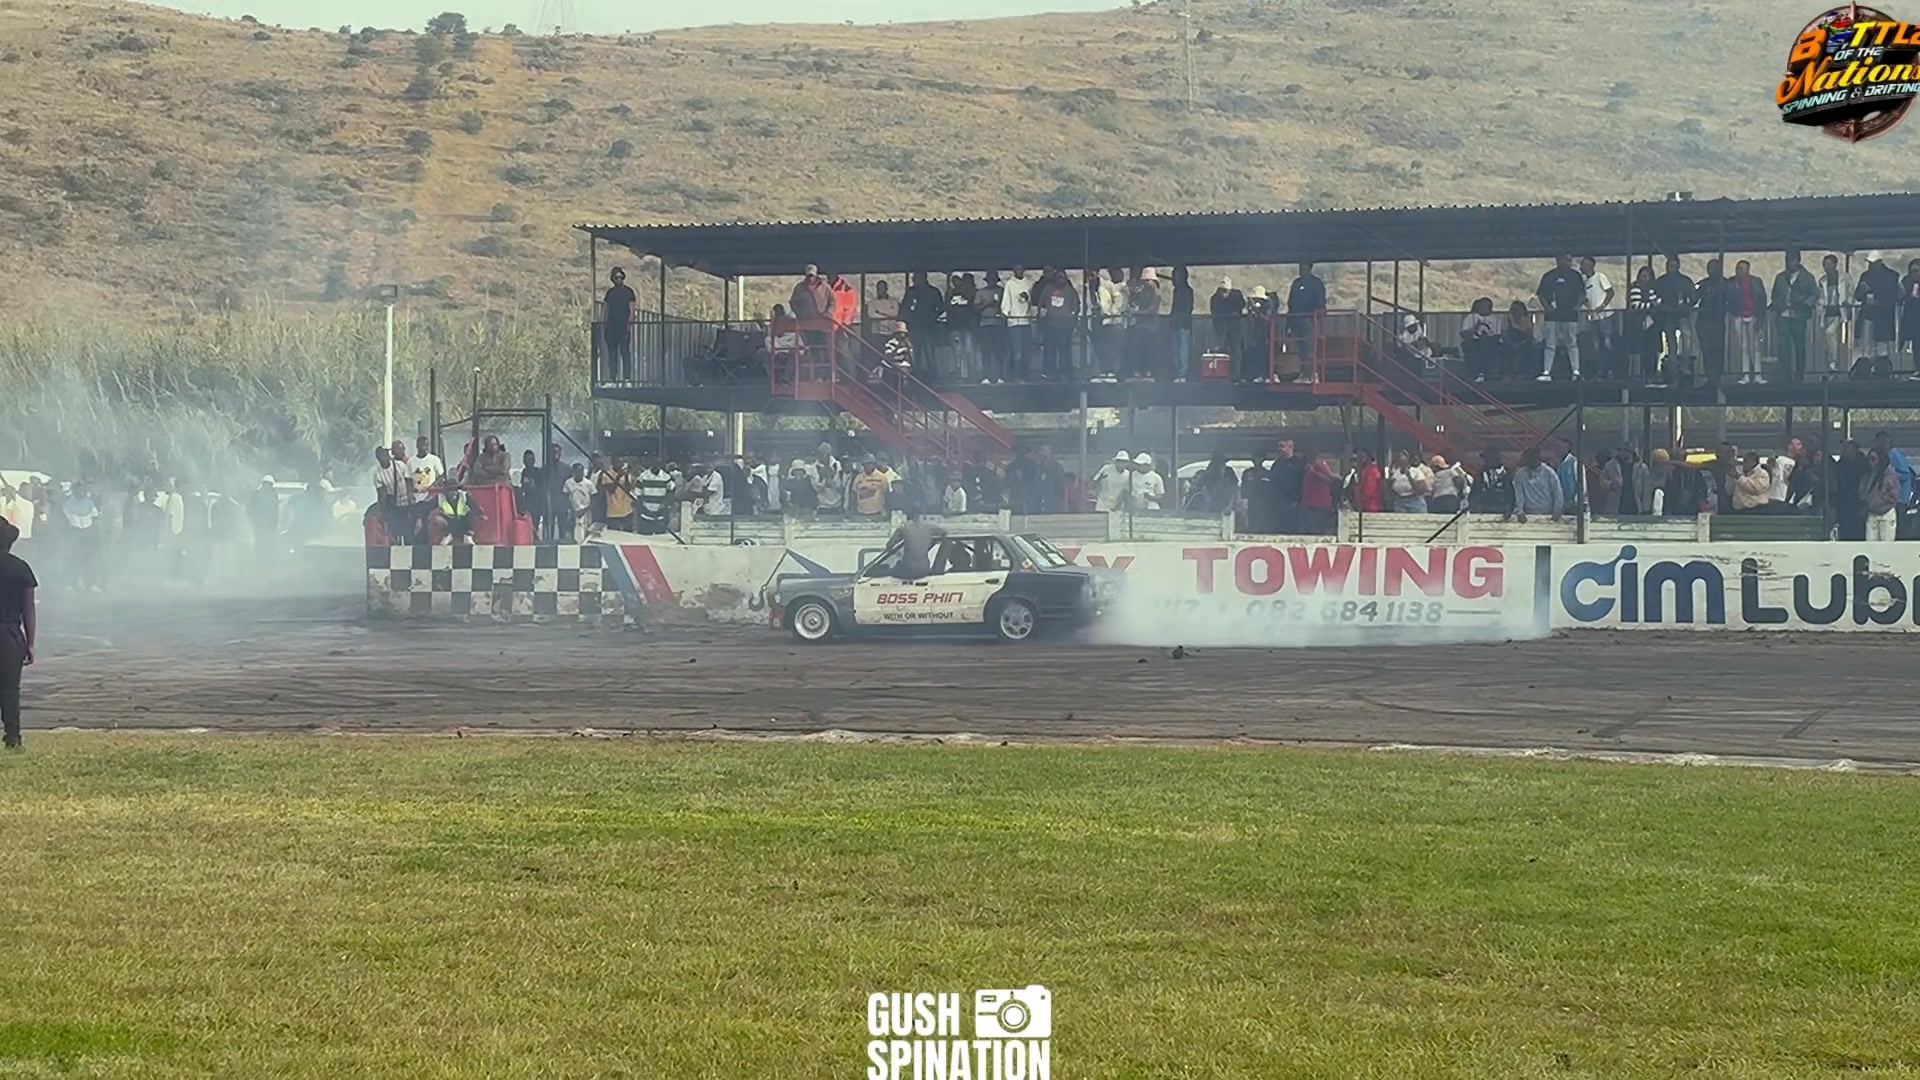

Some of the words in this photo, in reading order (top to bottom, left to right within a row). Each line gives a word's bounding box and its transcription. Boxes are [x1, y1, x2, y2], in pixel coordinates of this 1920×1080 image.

[1182, 545, 1505, 599] TOWING
[876, 593, 918, 604] BOSS
[1320, 601, 1378, 622] 684
[1386, 601, 1444, 623] 1138
